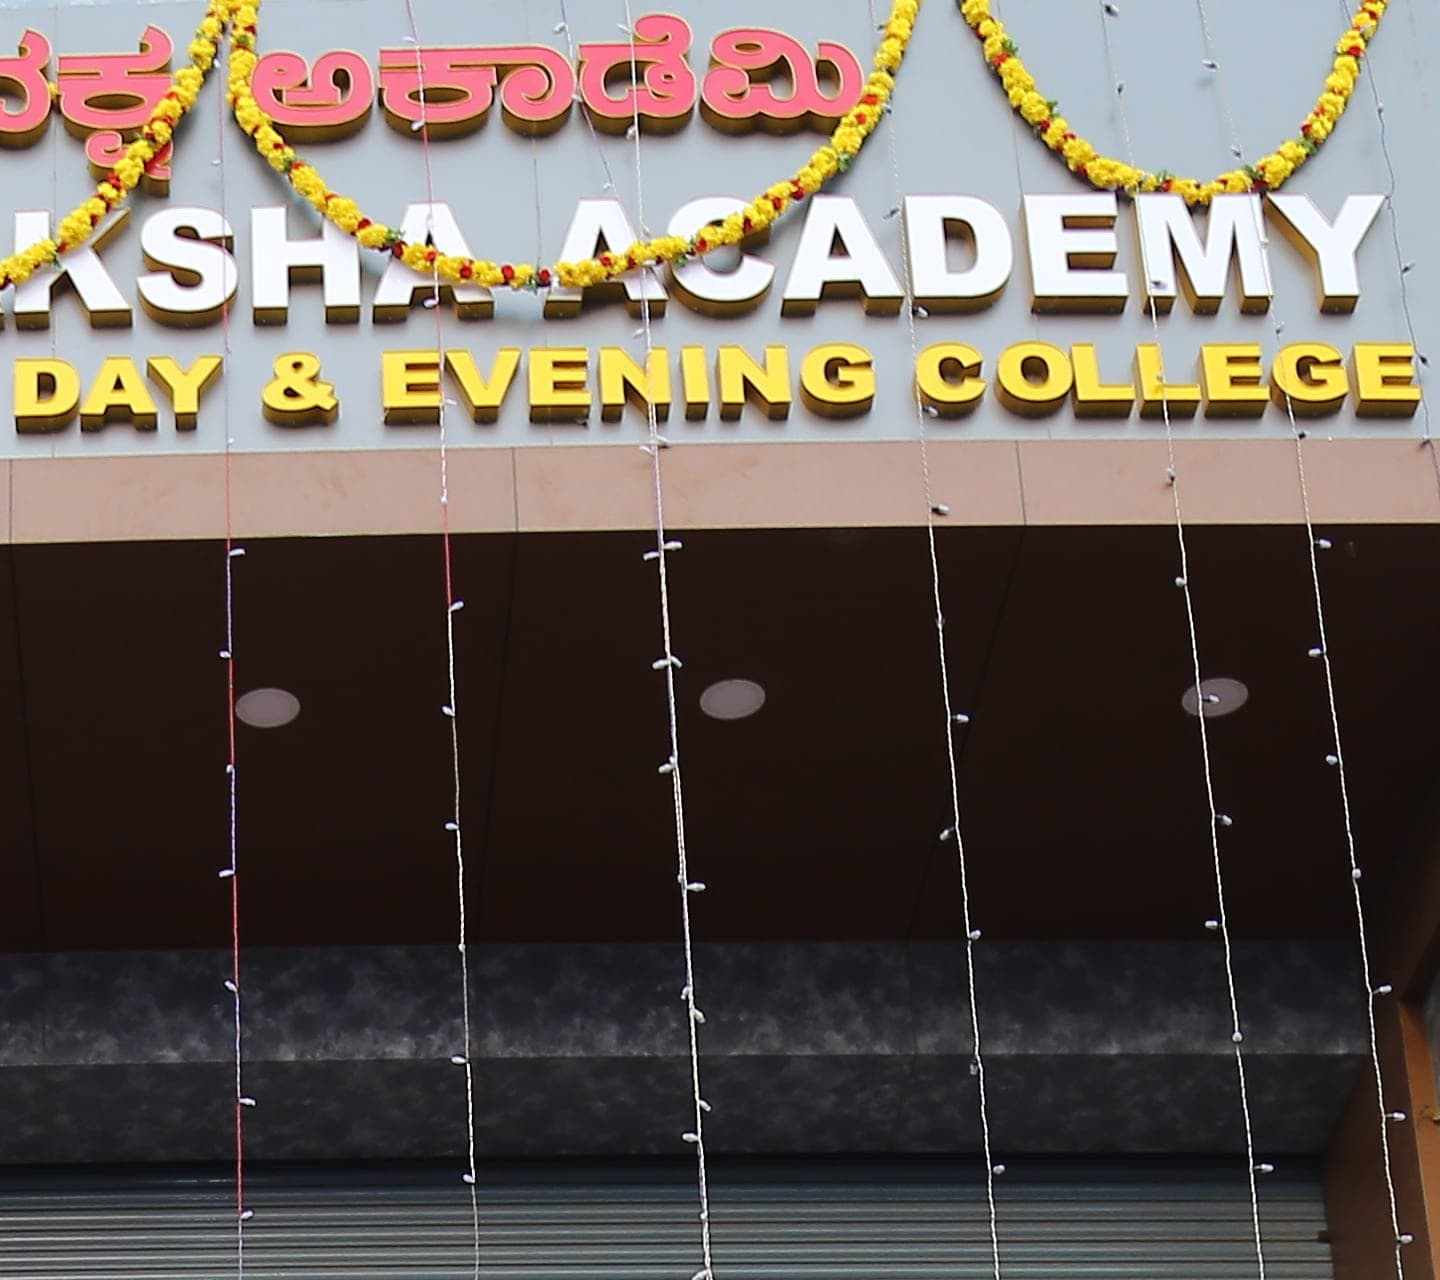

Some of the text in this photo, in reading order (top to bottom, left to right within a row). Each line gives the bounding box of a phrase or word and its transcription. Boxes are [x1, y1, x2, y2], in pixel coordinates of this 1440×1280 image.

[542, 191, 1386, 304] ACADEMY
[13, 340, 1423, 424] DAY & EVENING COLLEGE
